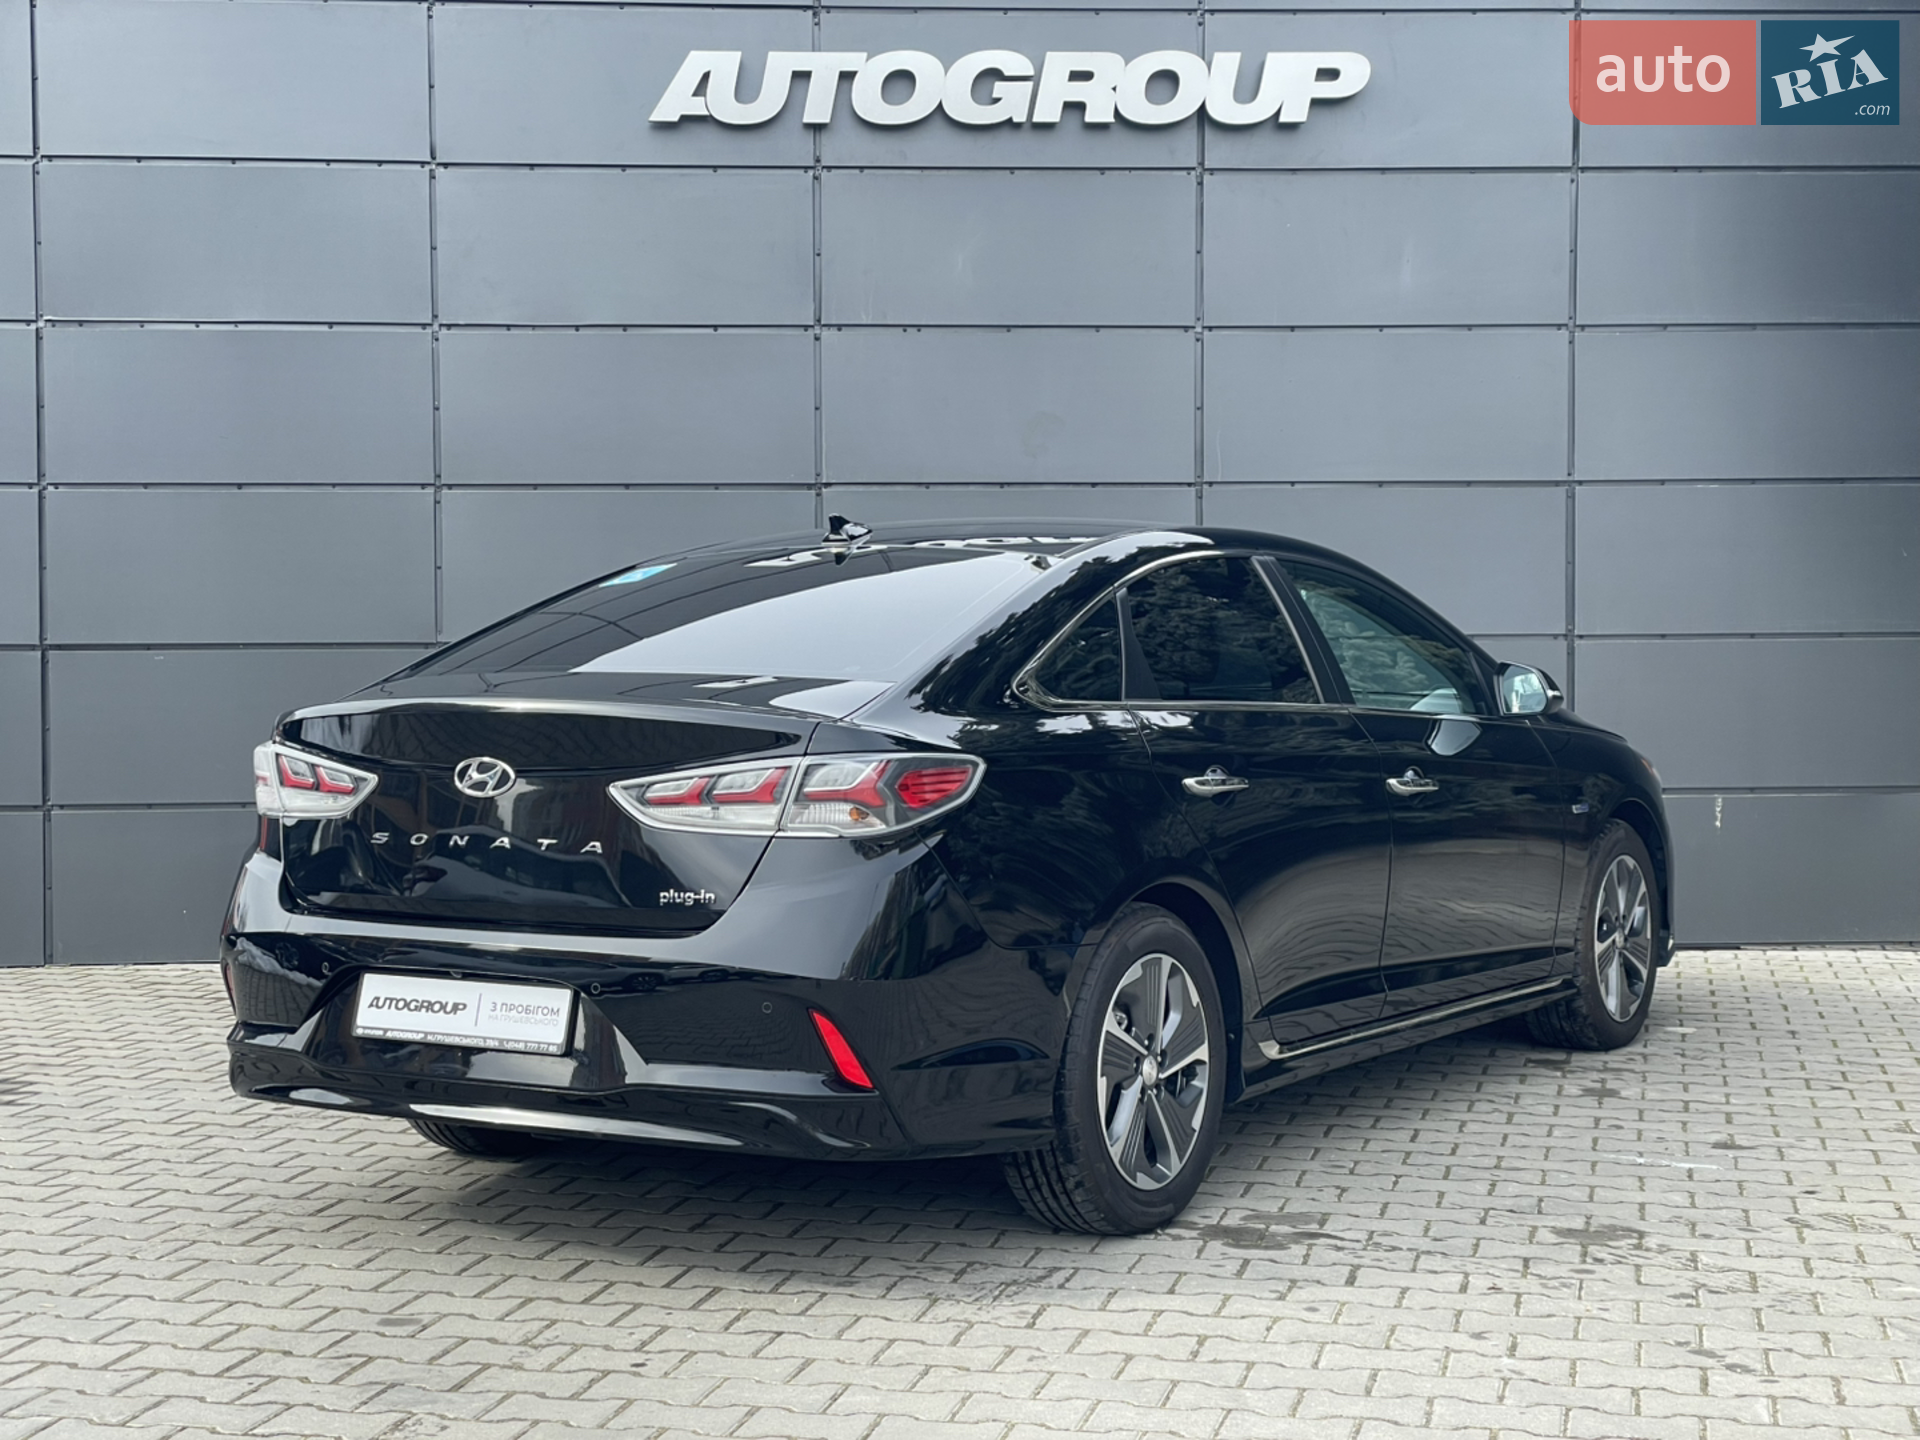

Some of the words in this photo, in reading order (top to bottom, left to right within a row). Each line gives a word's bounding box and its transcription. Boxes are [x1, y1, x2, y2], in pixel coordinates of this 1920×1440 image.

[648, 49, 1373, 127] AUTOGROUP
[370, 832, 604, 854] SONATA
[659, 888, 716, 906] plug-in
[367, 996, 468, 1016] AUTOGROUP
[500, 1002, 561, 1018] ПРОБІГОМ
